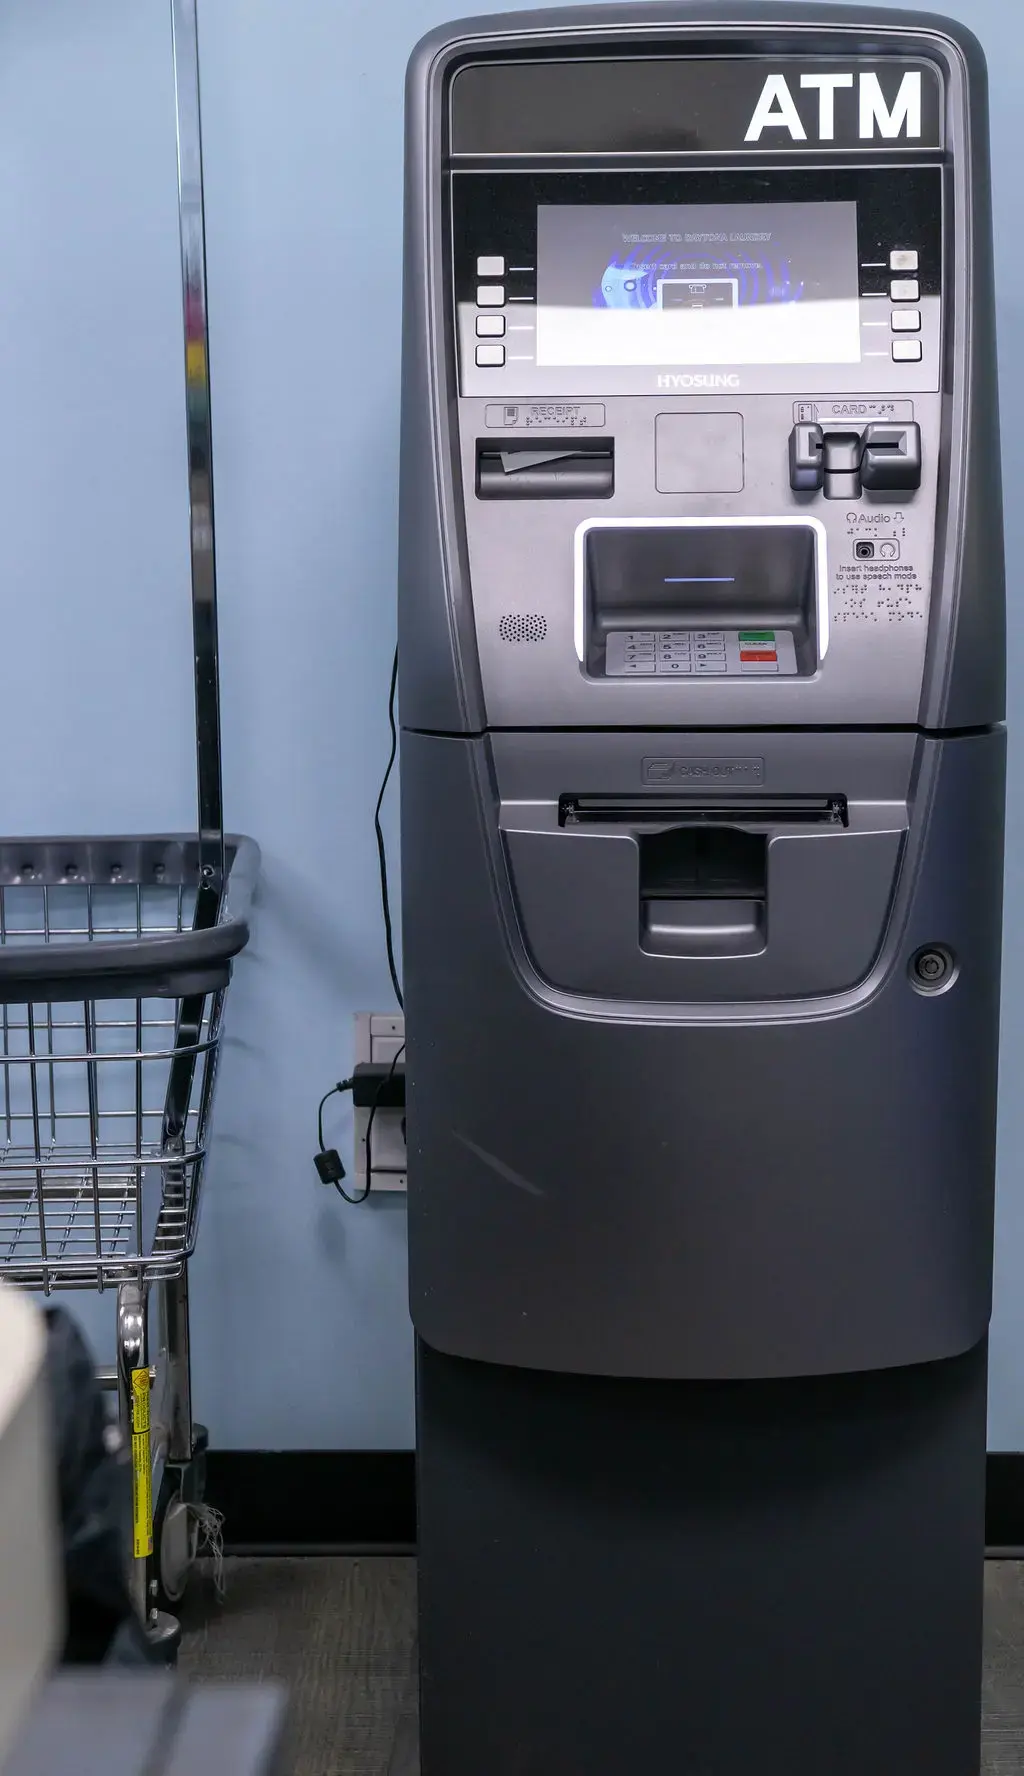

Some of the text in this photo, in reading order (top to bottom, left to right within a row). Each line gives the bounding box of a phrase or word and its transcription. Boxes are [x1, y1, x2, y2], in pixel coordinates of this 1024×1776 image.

[744, 72, 921, 141] ATM
[668, 233, 683, 243] TO
[657, 373, 740, 388] HYOSUNG
[531, 406, 581, 416] RECEIPT
[832, 404, 867, 414] CARD
[858, 513, 891, 524] Audio
[839, 564, 914, 574] Insert headphones
[863, 573, 892, 582] speech
[894, 572, 917, 580] mode
